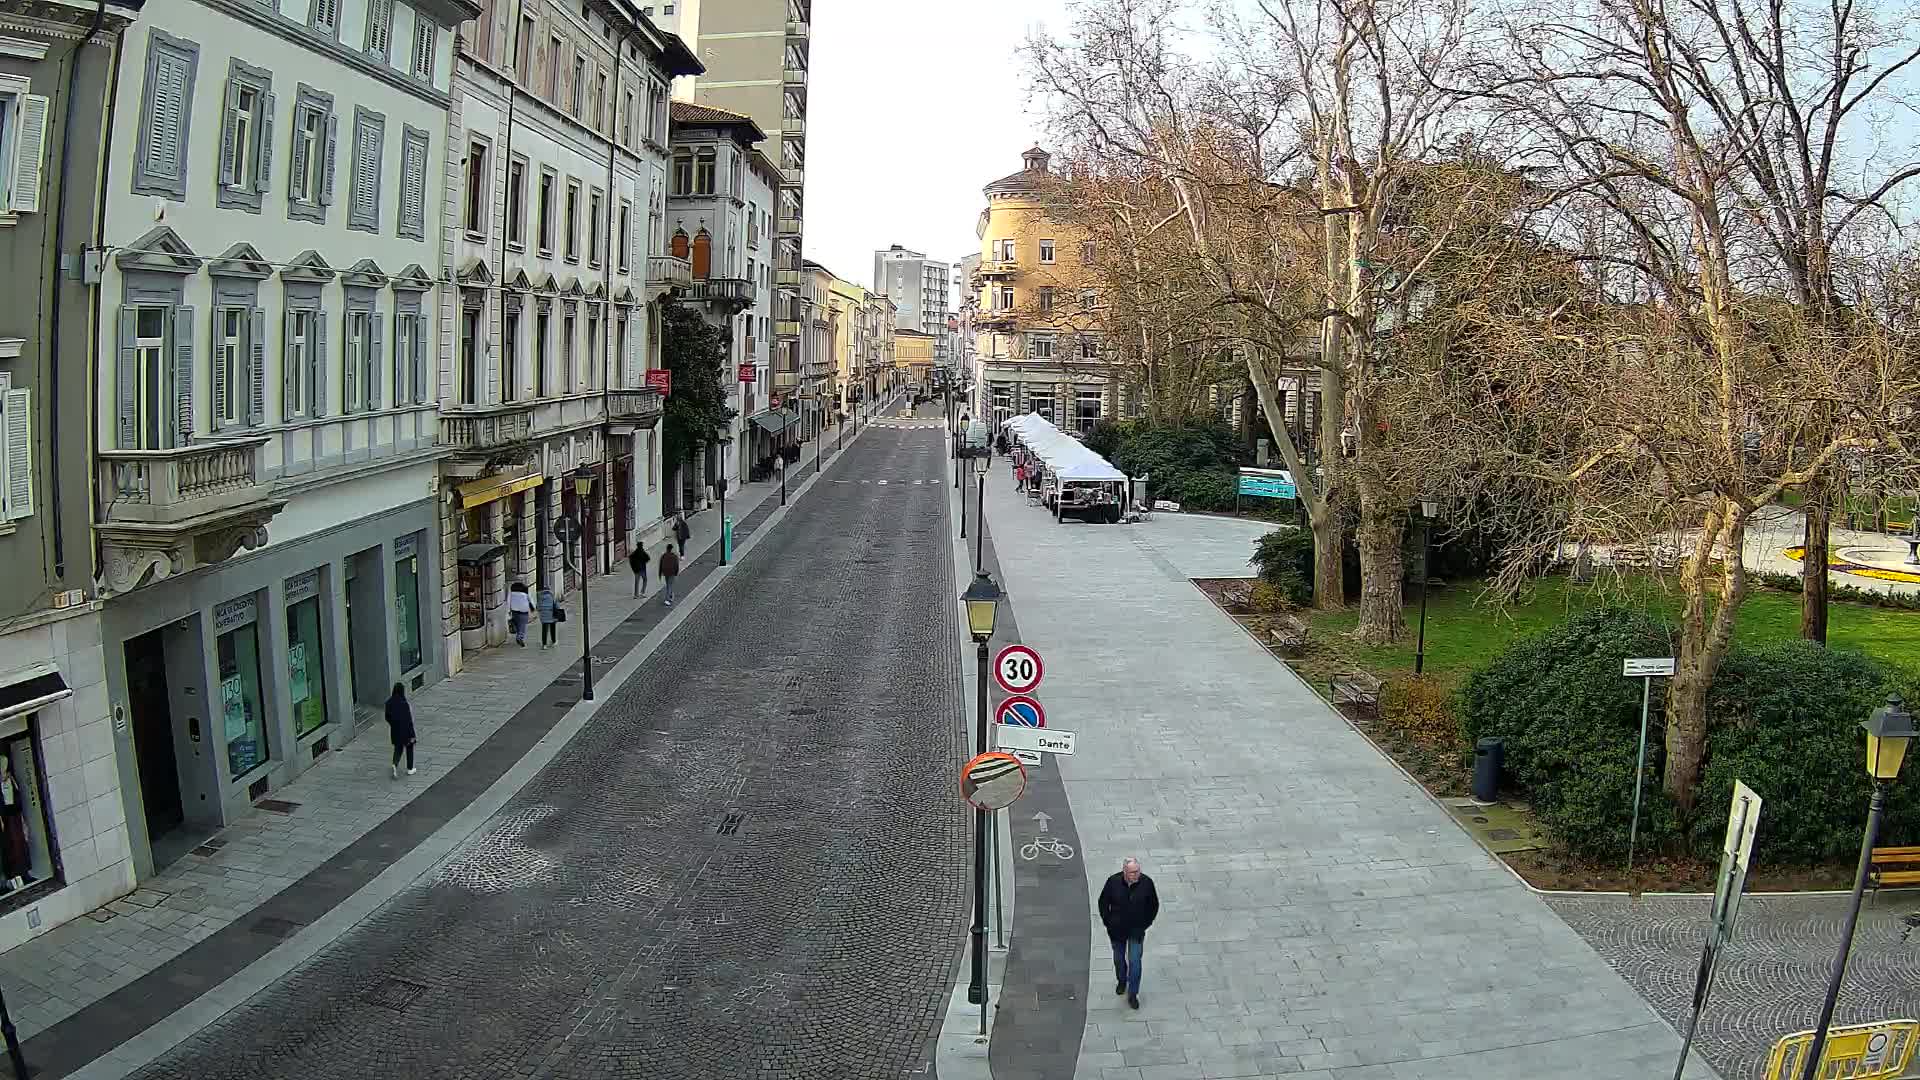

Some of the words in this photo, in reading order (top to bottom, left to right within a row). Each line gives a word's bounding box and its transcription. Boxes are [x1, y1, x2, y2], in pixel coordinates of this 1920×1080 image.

[1005, 658, 1033, 680] 30
[222, 678, 240, 700] 130
[1039, 738, 1070, 750] Dante
